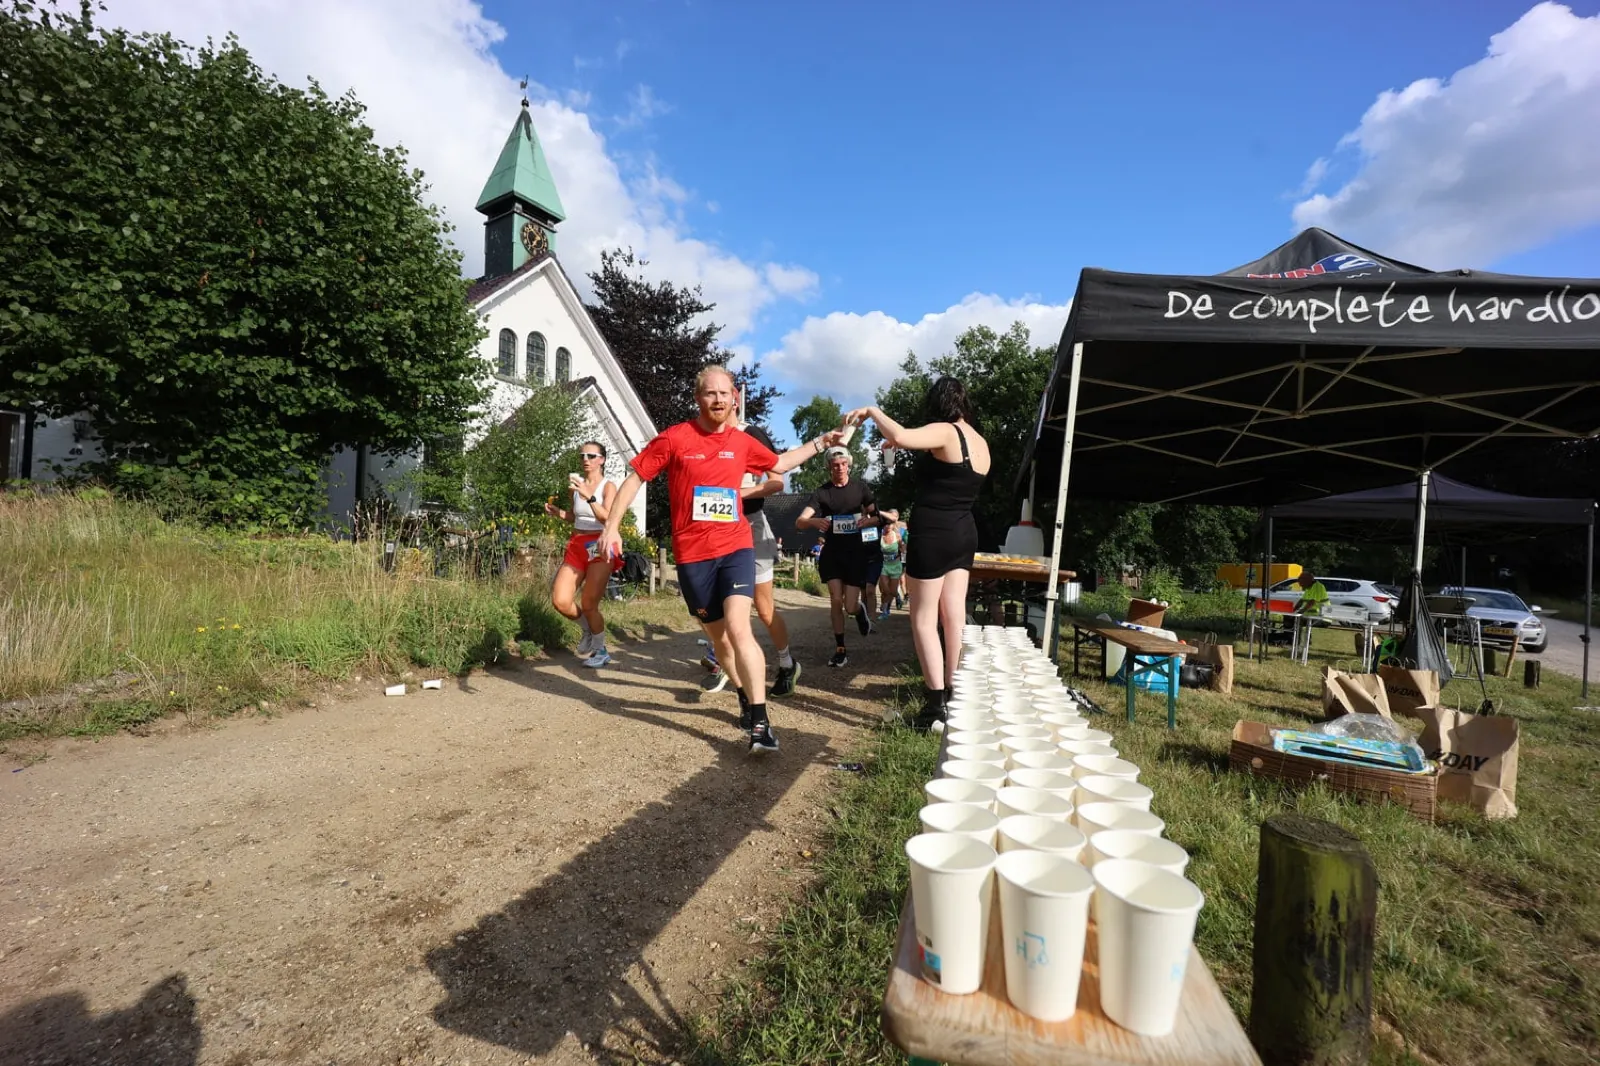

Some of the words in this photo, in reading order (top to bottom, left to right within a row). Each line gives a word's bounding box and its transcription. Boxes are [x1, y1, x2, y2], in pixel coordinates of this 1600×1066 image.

[1164, 291, 1216, 320] De
[1229, 281, 1434, 333] complete
[1448, 285, 1600, 324] hardlo
[700, 502, 733, 515] 1422
